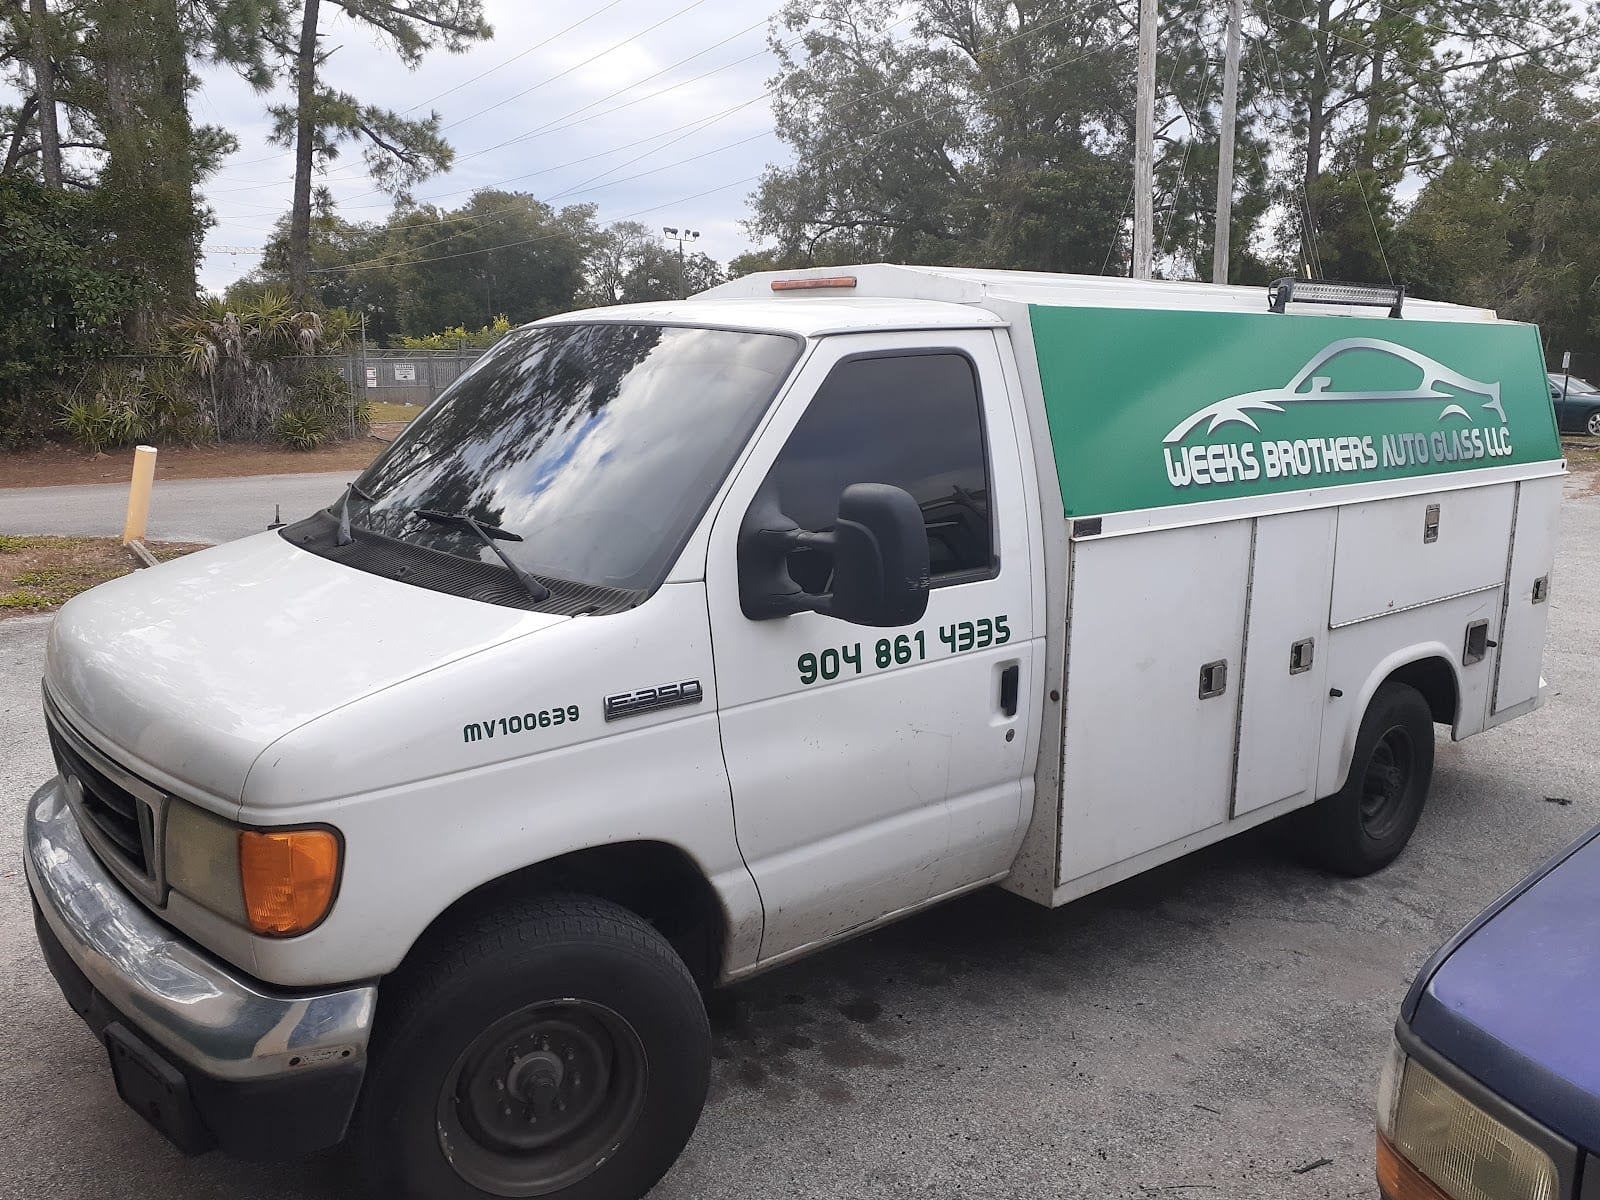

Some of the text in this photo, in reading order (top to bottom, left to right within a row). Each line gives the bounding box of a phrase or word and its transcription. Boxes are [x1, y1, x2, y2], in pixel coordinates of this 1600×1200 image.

[1163, 426, 1513, 487] WEEKS BROTHERS AUTO GLASS LLC
[797, 614, 1011, 685] 904 861 4335
[463, 704, 580, 743] MV100639
